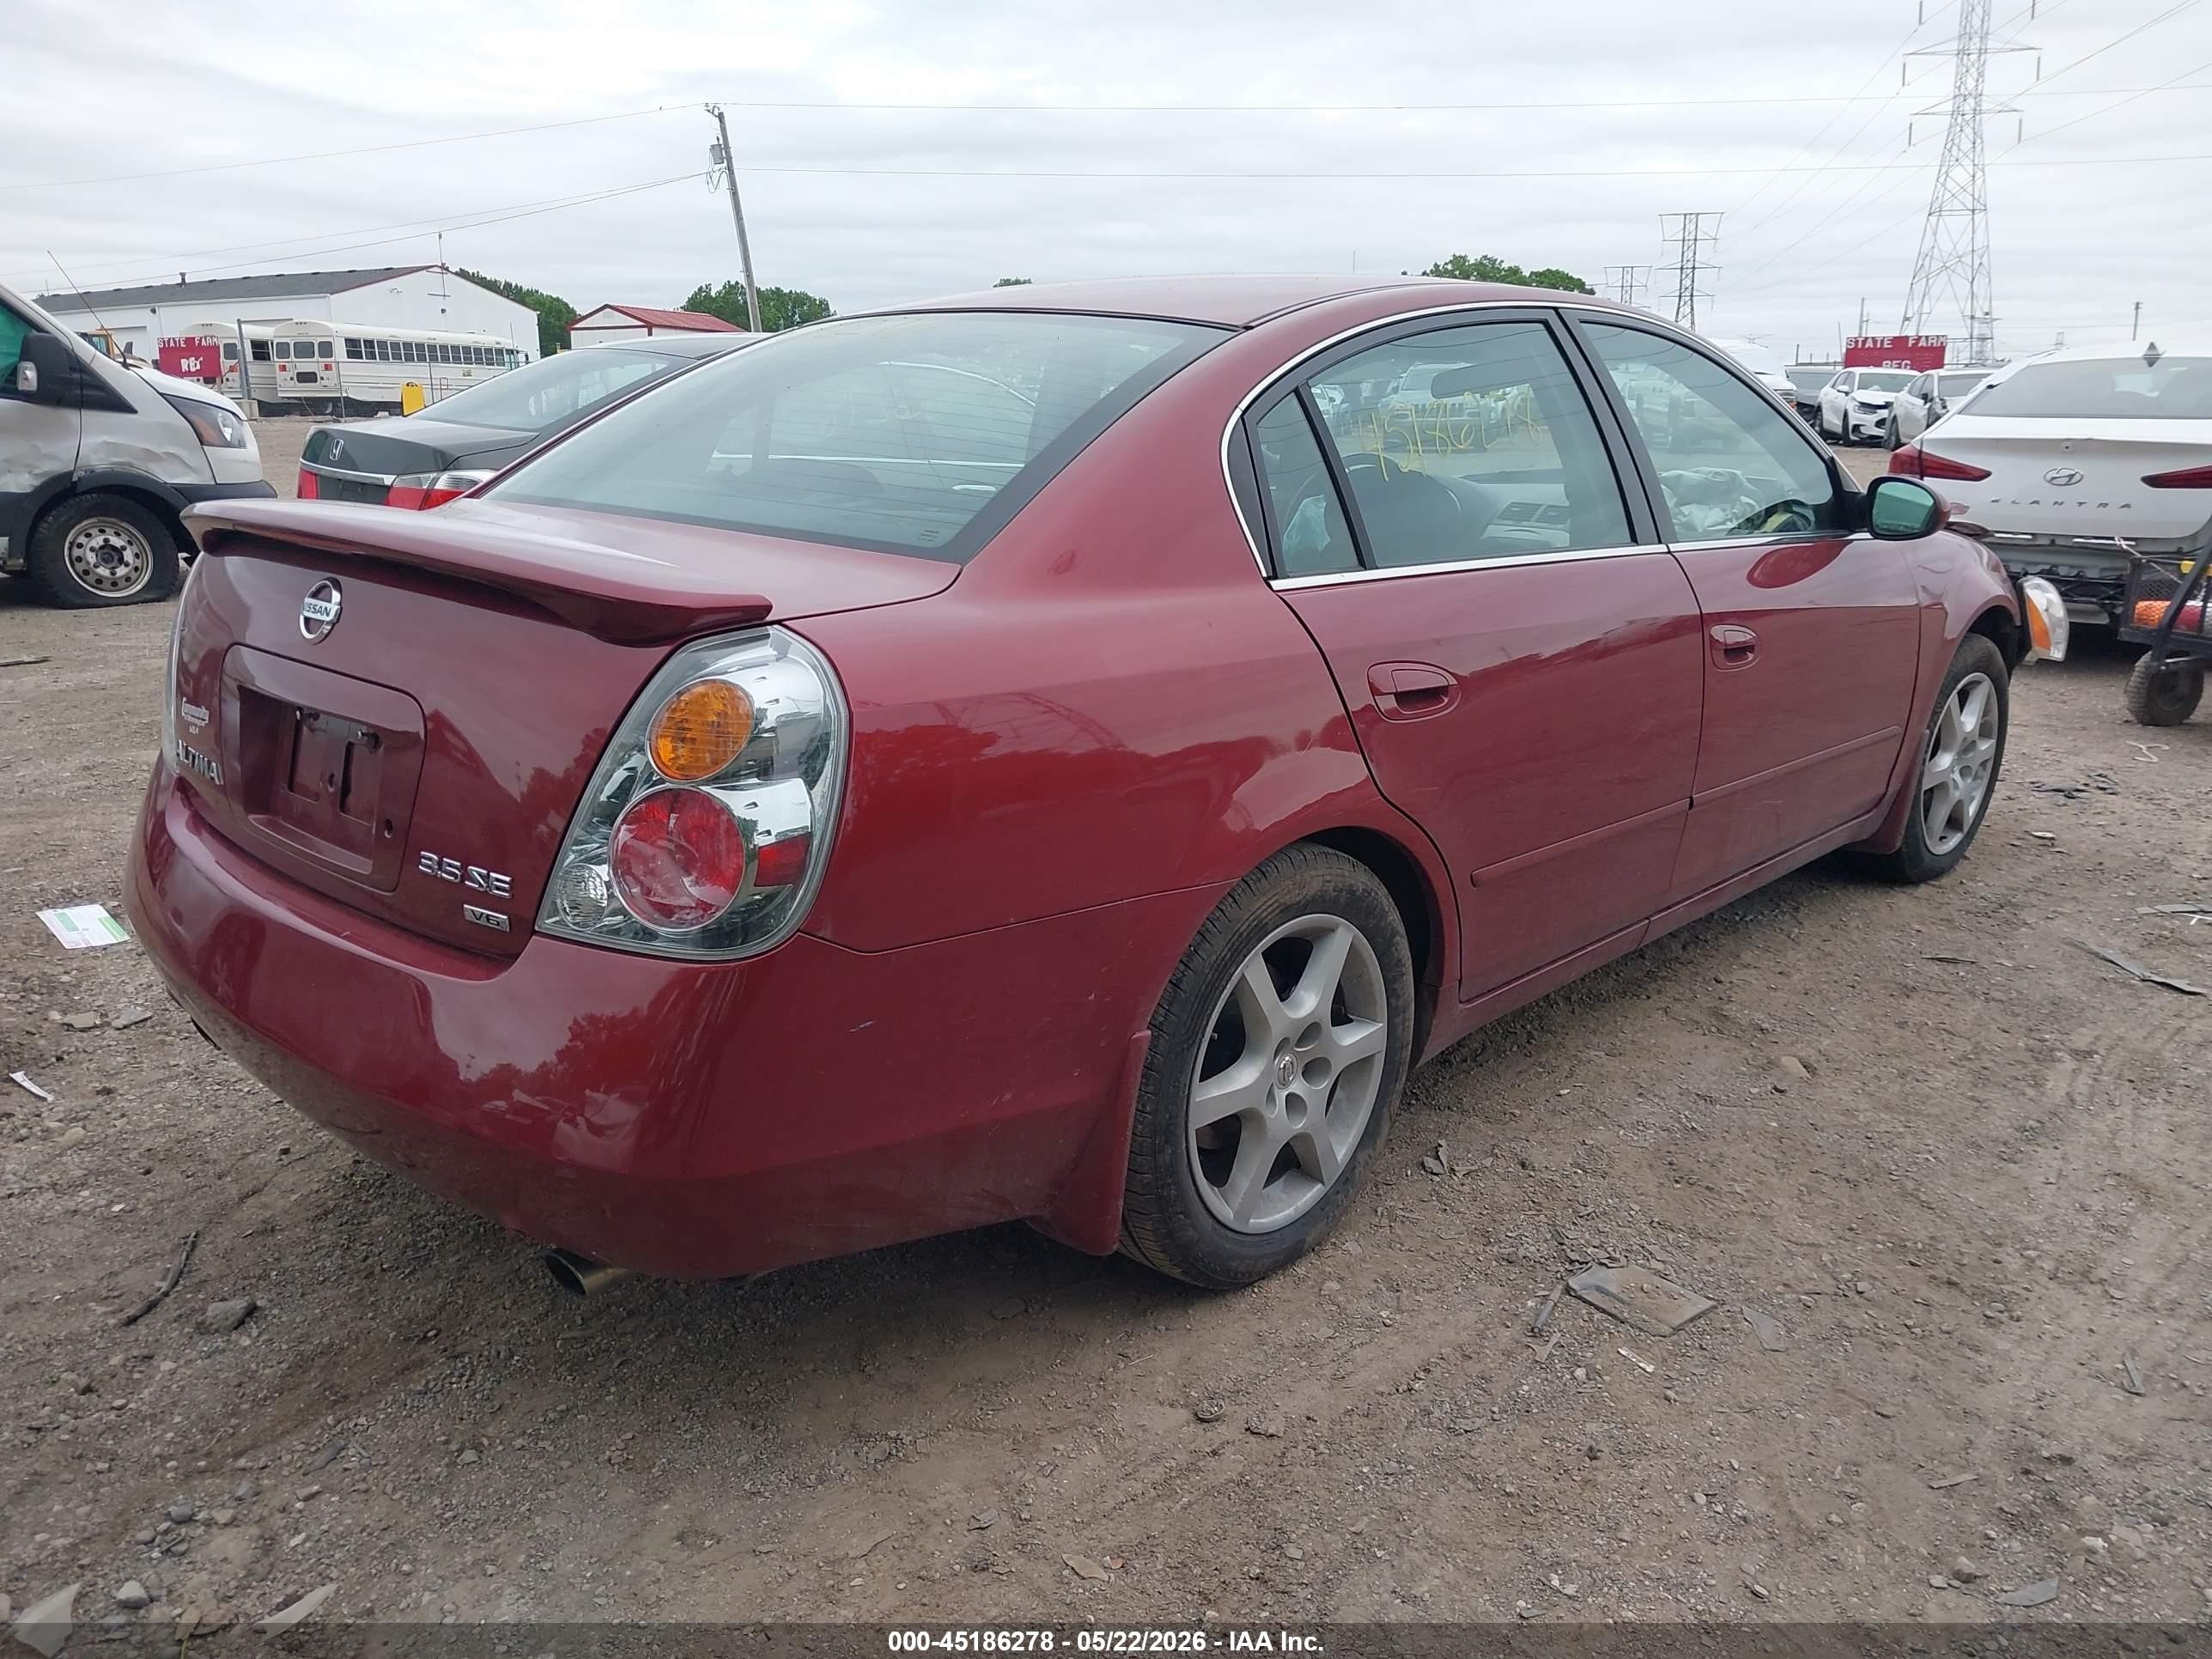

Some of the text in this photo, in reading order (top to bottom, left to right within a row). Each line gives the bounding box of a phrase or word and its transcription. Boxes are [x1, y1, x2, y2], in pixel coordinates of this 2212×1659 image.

[157, 336, 219, 349] STATE FARM
[1846, 335, 1948, 349] STATE FARM
[418, 851, 513, 899] 3.5 SE
[470, 908, 501, 927] V6
